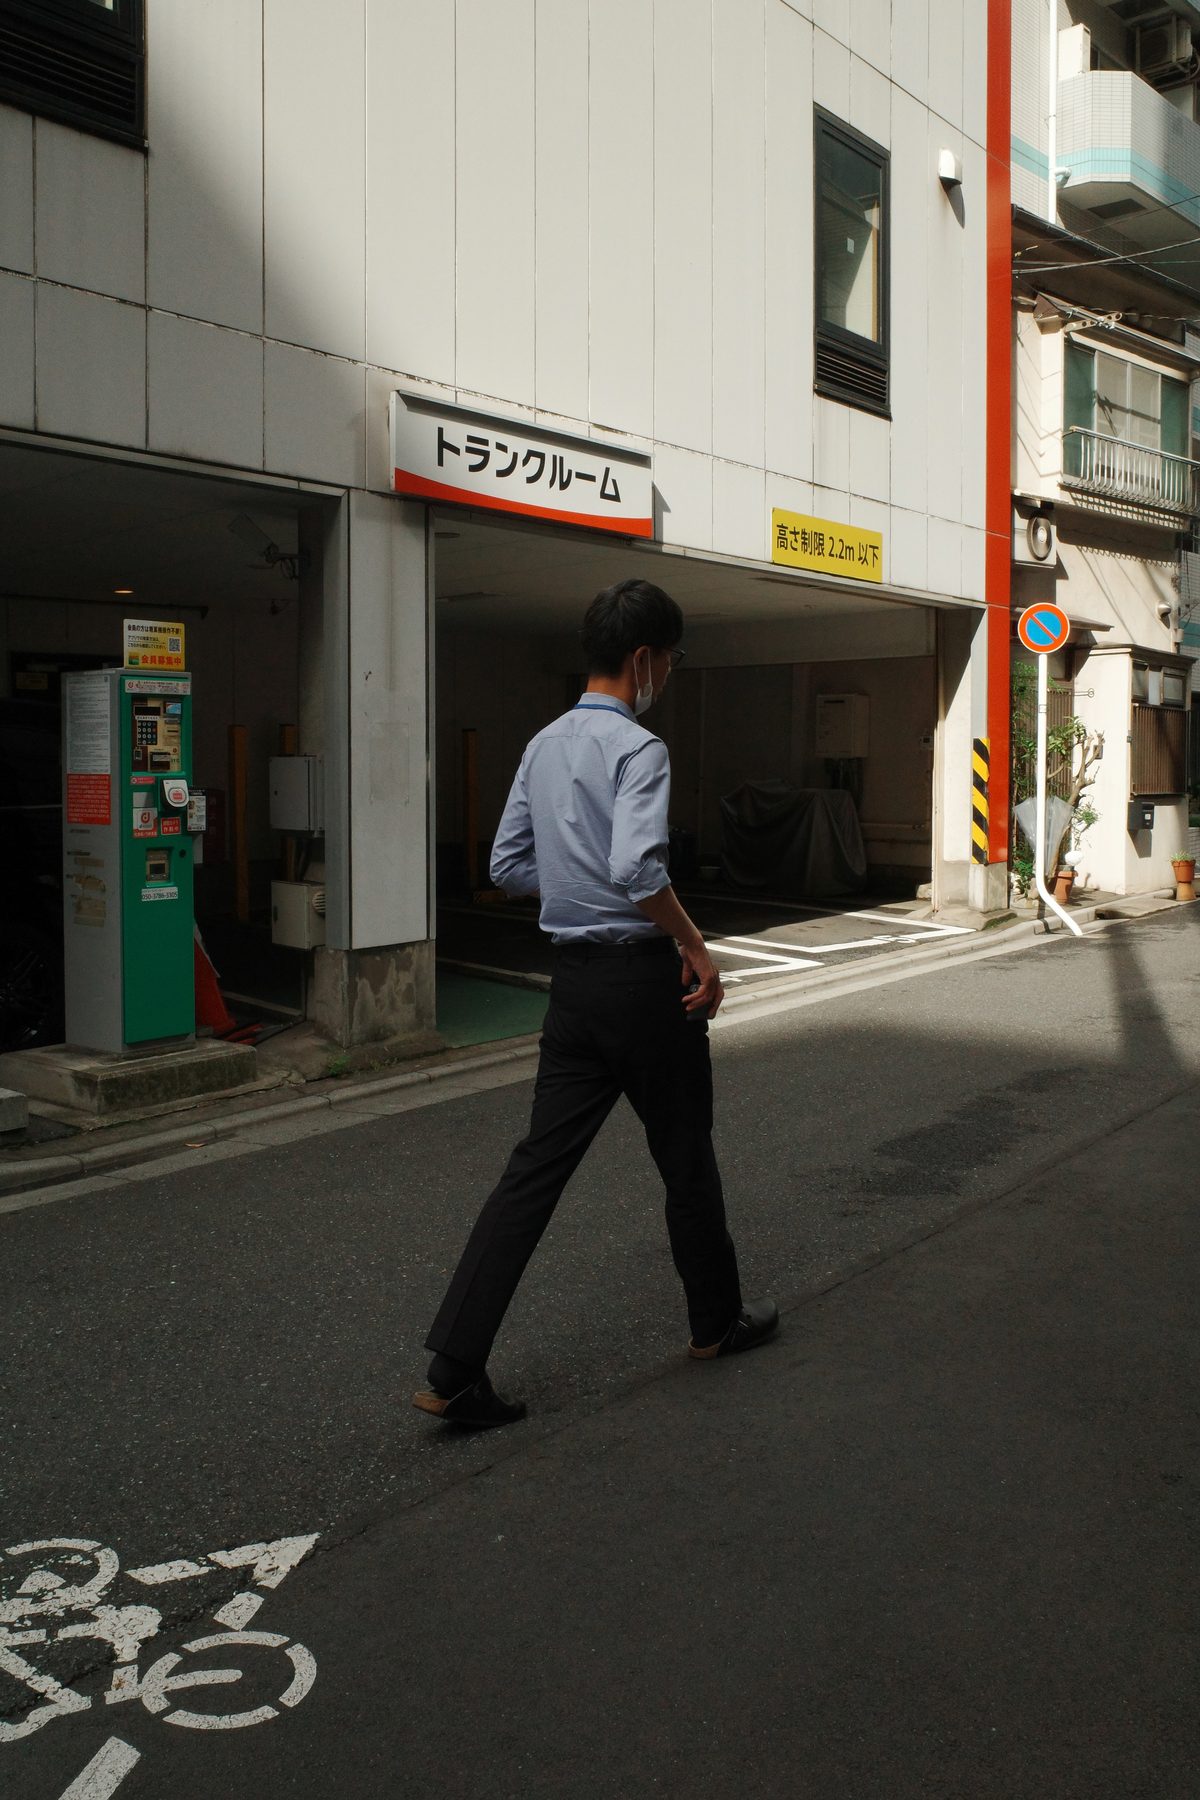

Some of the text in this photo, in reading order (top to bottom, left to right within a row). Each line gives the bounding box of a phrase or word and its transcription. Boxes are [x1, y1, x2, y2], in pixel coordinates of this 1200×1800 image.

[437, 426, 621, 502] トランクルーム
[141, 655, 182, 666] 会員募集中
